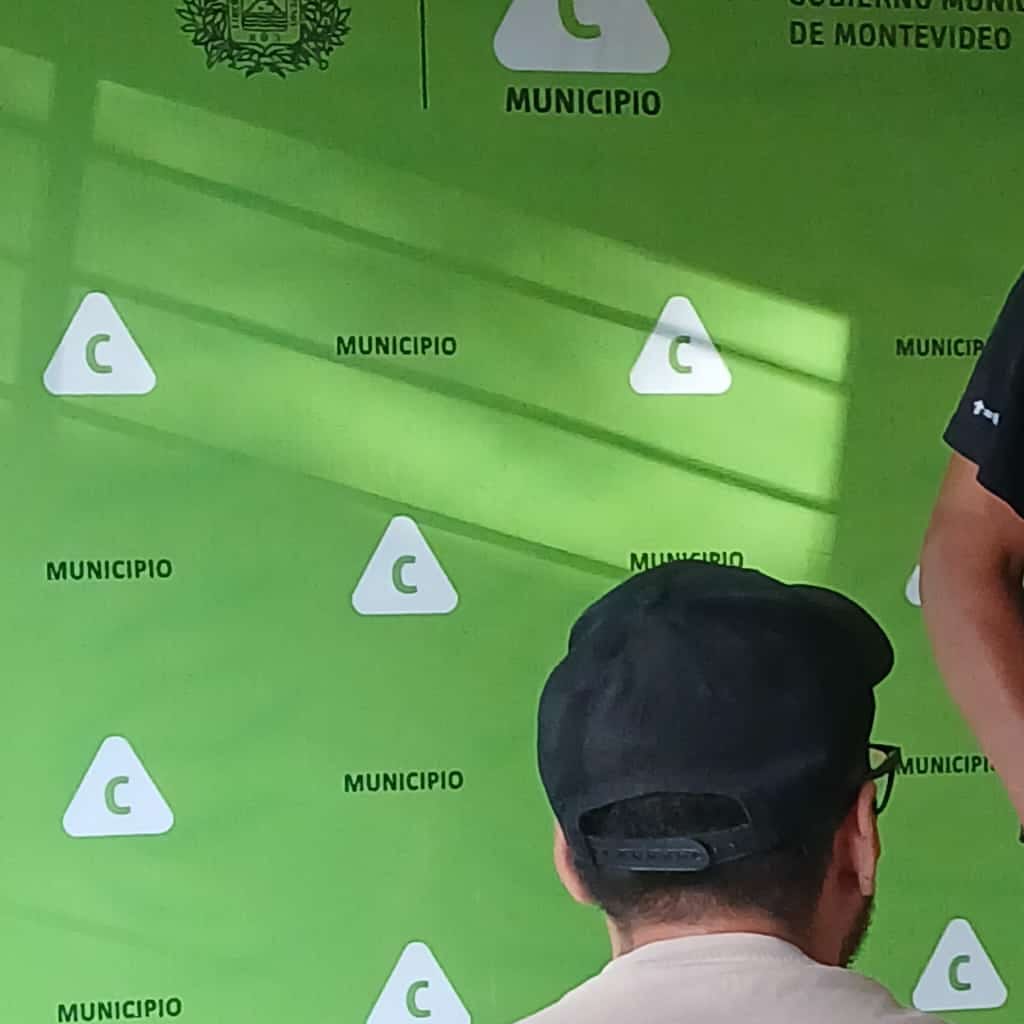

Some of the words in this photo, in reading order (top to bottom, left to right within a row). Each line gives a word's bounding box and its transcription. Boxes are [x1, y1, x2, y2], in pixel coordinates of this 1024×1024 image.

[790, 21, 825, 46] DE
[834, 23, 1012, 50] MONTEVIDEO
[506, 86, 662, 116] MUNICIPIO
[86, 334, 113, 374] C
[336, 335, 457, 356] MUNICIPIO
[668, 336, 692, 374] C
[895, 338, 984, 357] MUNICIP
[46, 559, 173, 581] MUNICIPIO
[392, 555, 417, 594] C
[898, 755, 995, 775] MUNICIPI
[104, 776, 131, 815] C
[344, 770, 464, 793] MUNICIPIO
[948, 955, 971, 992] C
[58, 997, 182, 1023] MUNICIPIO
[405, 980, 431, 1018] C
